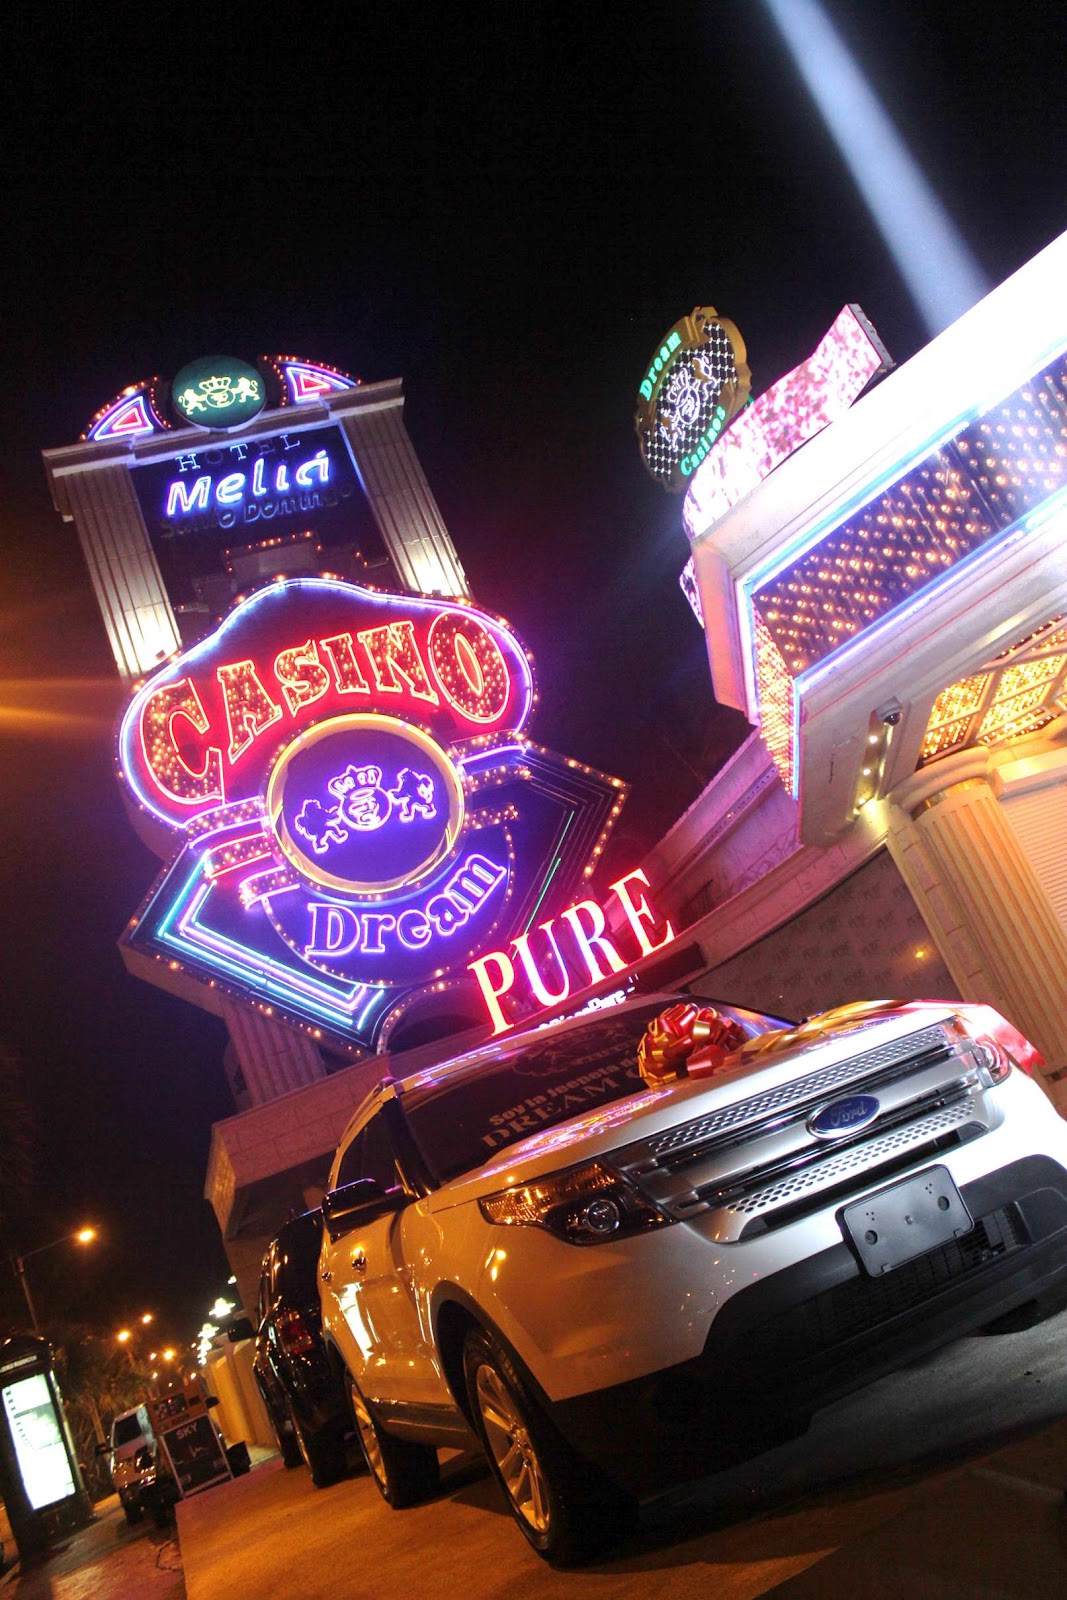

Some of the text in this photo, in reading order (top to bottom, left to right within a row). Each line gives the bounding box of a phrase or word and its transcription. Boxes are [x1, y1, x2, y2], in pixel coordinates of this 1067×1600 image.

[638, 331, 682, 401] Dream
[175, 434, 300, 472] HOTEL
[680, 405, 727, 476] Casinos
[139, 610, 511, 806] CASINO
[305, 853, 507, 956] Dream
[467, 868, 675, 1036] PURE
[481, 1076, 620, 1148] DREAM
[489, 1103, 527, 1126] Soy
[525, 1094, 548, 1108] la
[830, 1100, 867, 1126] Ford
[175, 1423, 199, 1440] SKY
